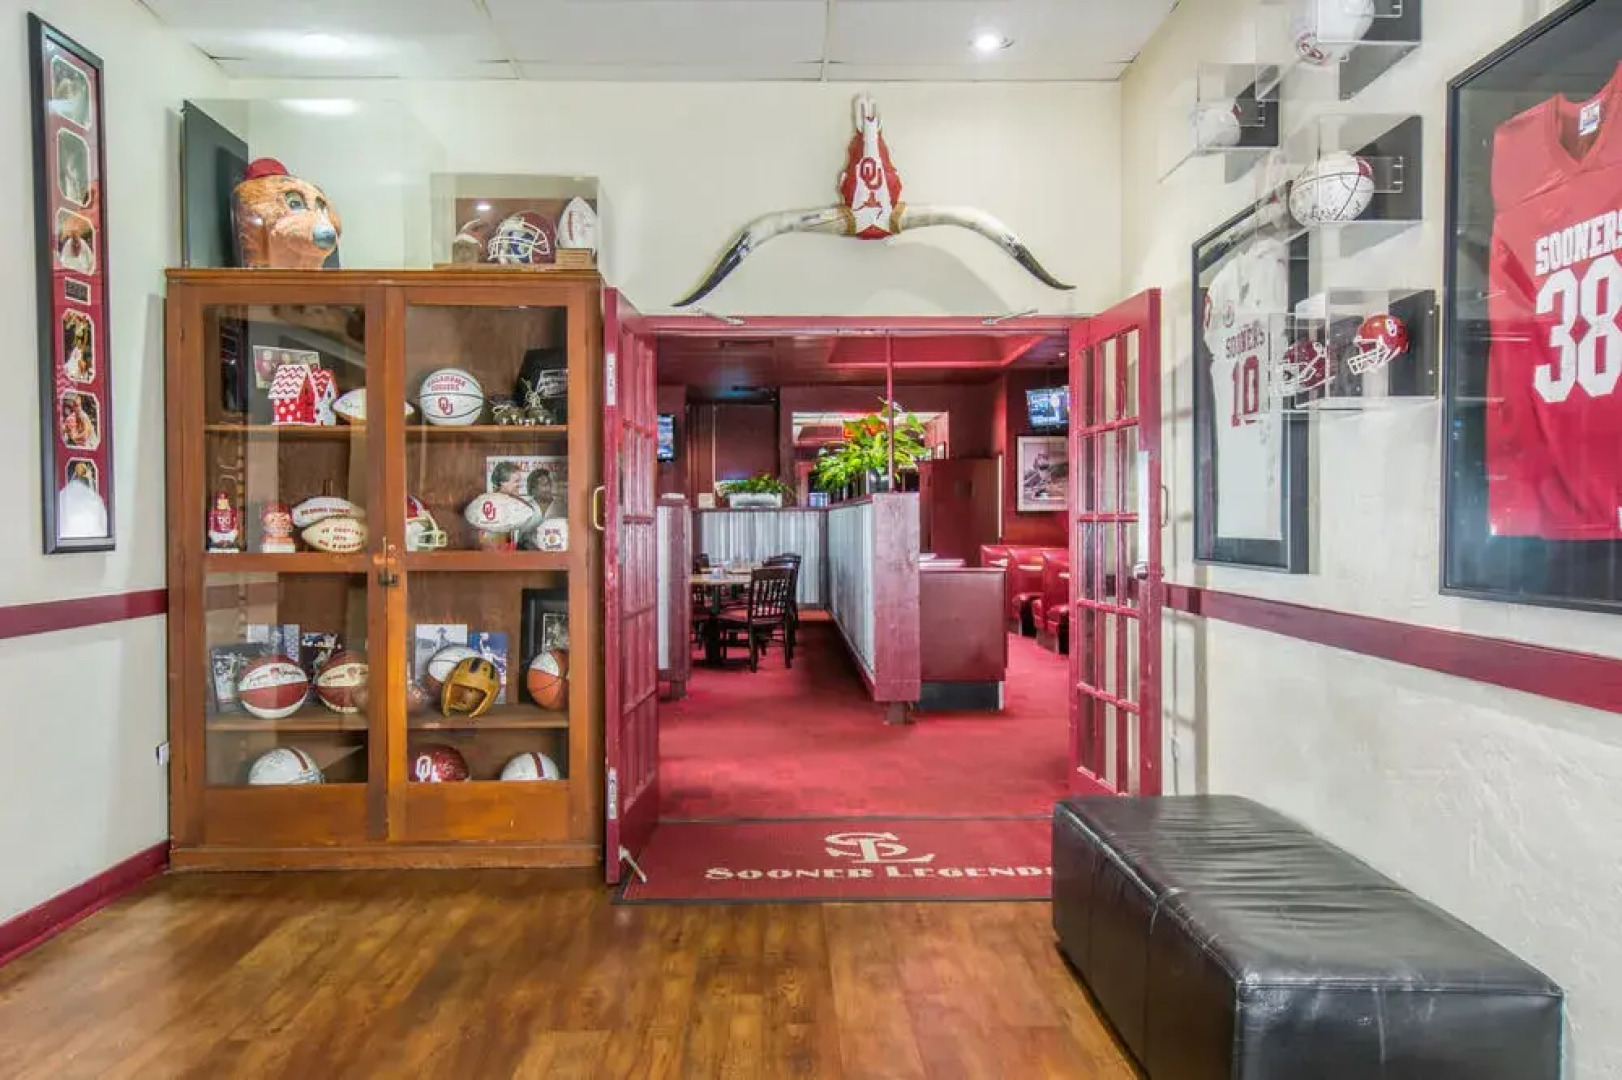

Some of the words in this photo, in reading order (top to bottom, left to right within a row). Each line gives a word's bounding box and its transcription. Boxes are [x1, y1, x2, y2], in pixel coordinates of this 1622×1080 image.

[860, 156, 883, 191] OU
[1534, 254, 1622, 403] 38
[437, 396, 454, 416] OU
[1230, 354, 1260, 427] 10
[482, 500, 497, 521] OU
